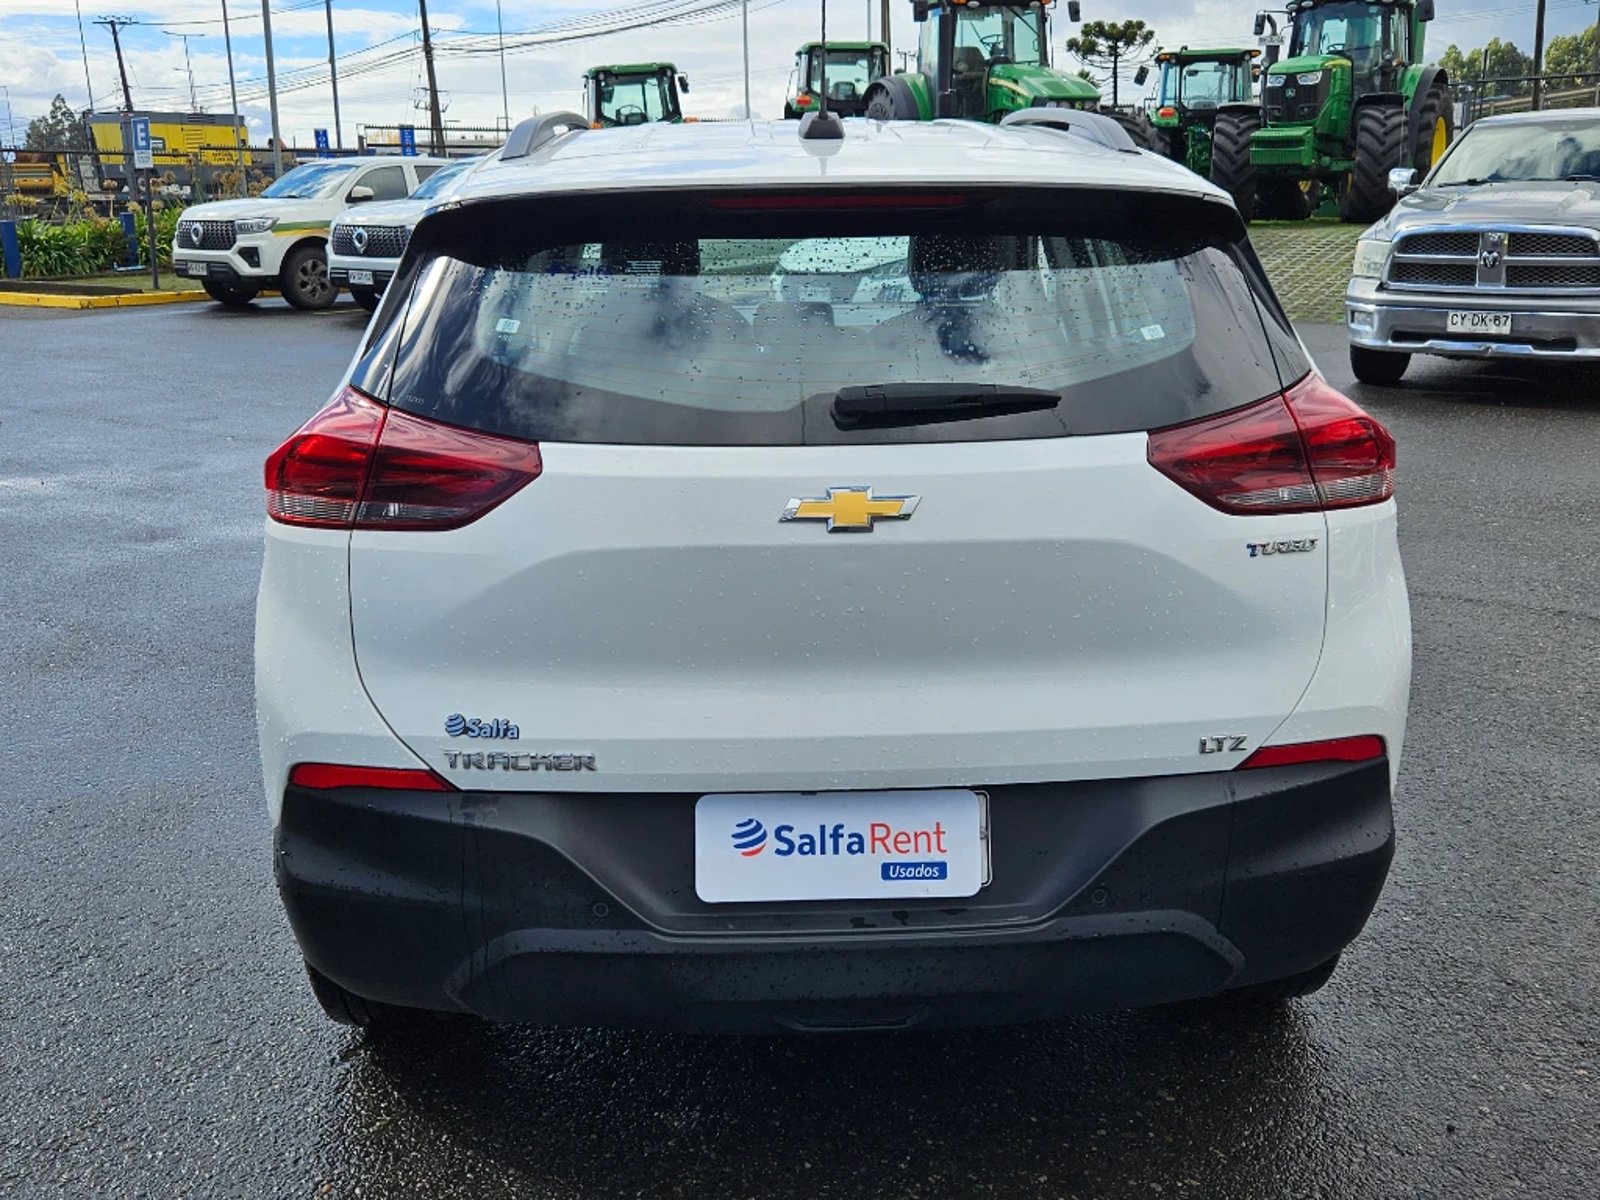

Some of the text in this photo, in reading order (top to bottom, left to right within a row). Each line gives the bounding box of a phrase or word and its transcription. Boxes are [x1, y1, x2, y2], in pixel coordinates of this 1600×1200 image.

[136, 123, 147, 146] E
[467, 718, 520, 739] Salfa
[1199, 734, 1248, 754] LTZ
[444, 750, 597, 771] TRACKER
[889, 864, 940, 878] Usados
